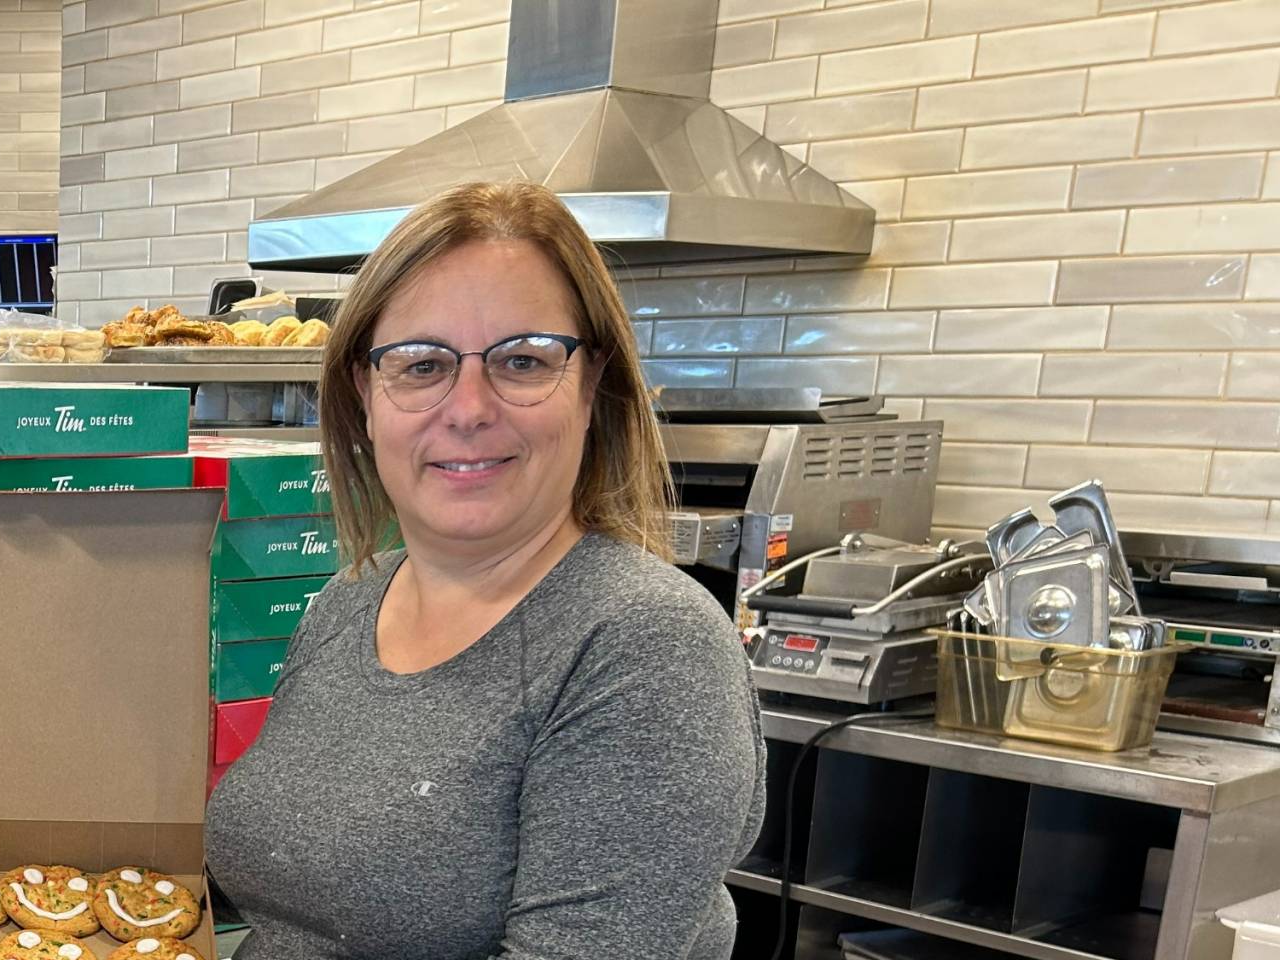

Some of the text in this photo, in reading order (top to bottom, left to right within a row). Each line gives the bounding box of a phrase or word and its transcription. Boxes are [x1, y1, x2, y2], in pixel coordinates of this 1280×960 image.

[16, 405, 133, 433] JOYEUX Tim DES FÊTES
[278, 479, 308, 493] JOYEUX
[267, 541, 298, 554] JOYEUX
[300, 530, 330, 556] Tim
[269, 602, 301, 615] JOYEUX
